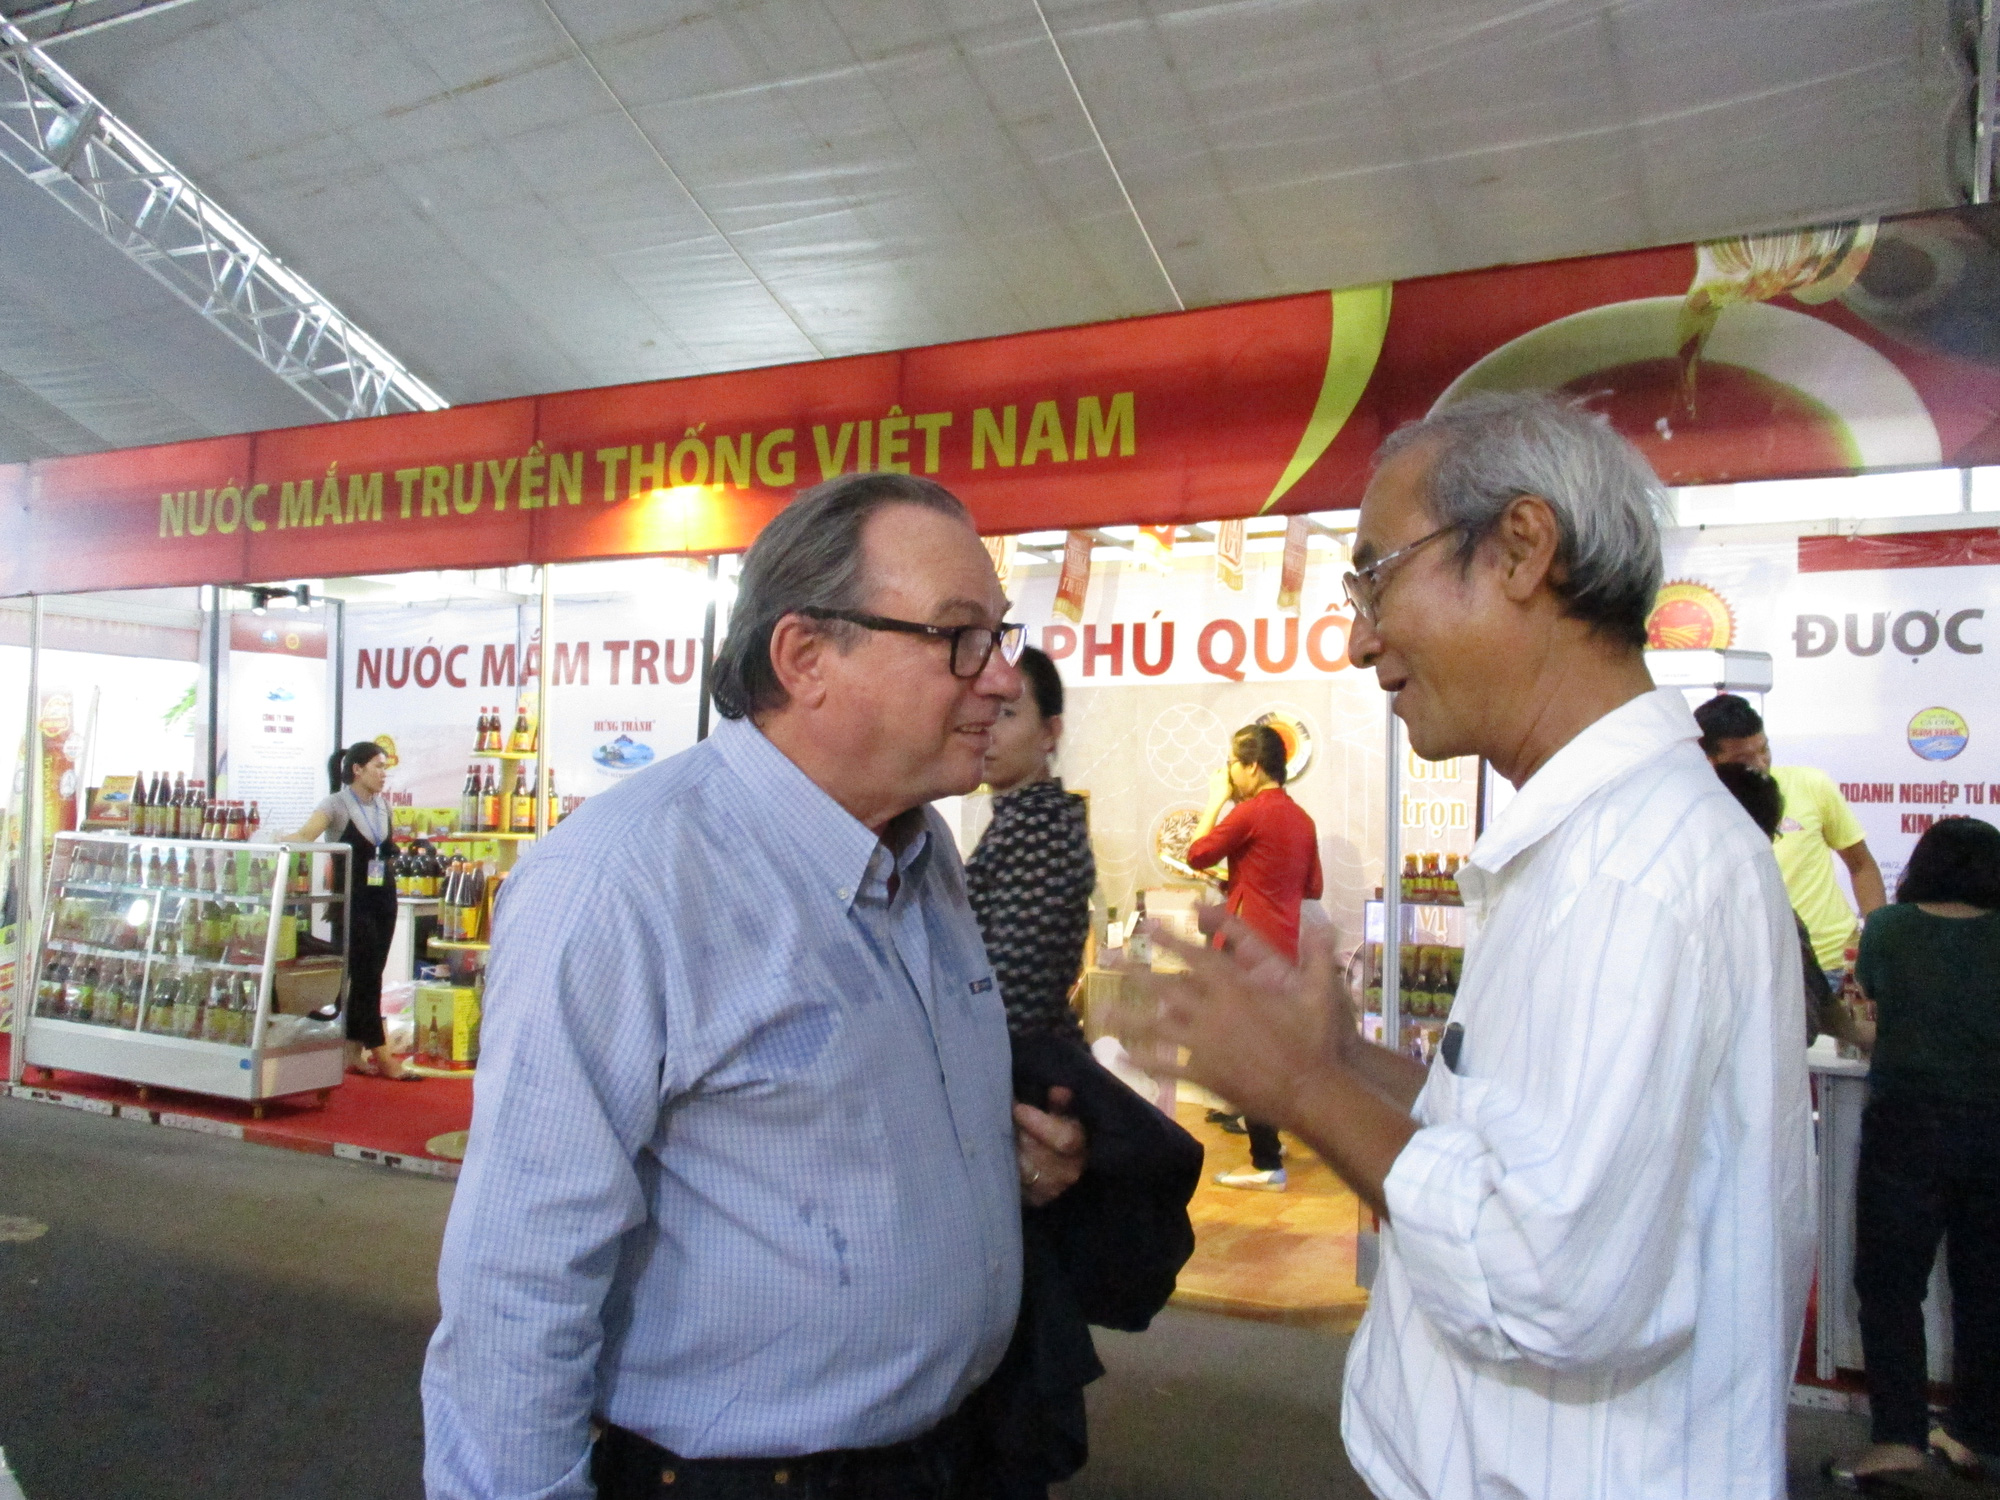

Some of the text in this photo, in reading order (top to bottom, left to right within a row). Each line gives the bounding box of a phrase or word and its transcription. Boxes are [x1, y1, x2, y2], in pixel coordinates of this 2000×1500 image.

[160, 477, 269, 538] NƯỚC
[277, 461, 383, 530] MẮM
[394, 440, 583, 520] TRUYỀN
[597, 423, 795, 502] THỐNG
[971, 391, 1135, 470] NAM
[356, 637, 468, 689] NƯỚC
[480, 627, 589, 687] MẮM
[1042, 610, 1175, 677] PHÚ
[1791, 607, 1985, 664] ĐƯỢC
[1899, 780, 1959, 809] NGHIỆP
